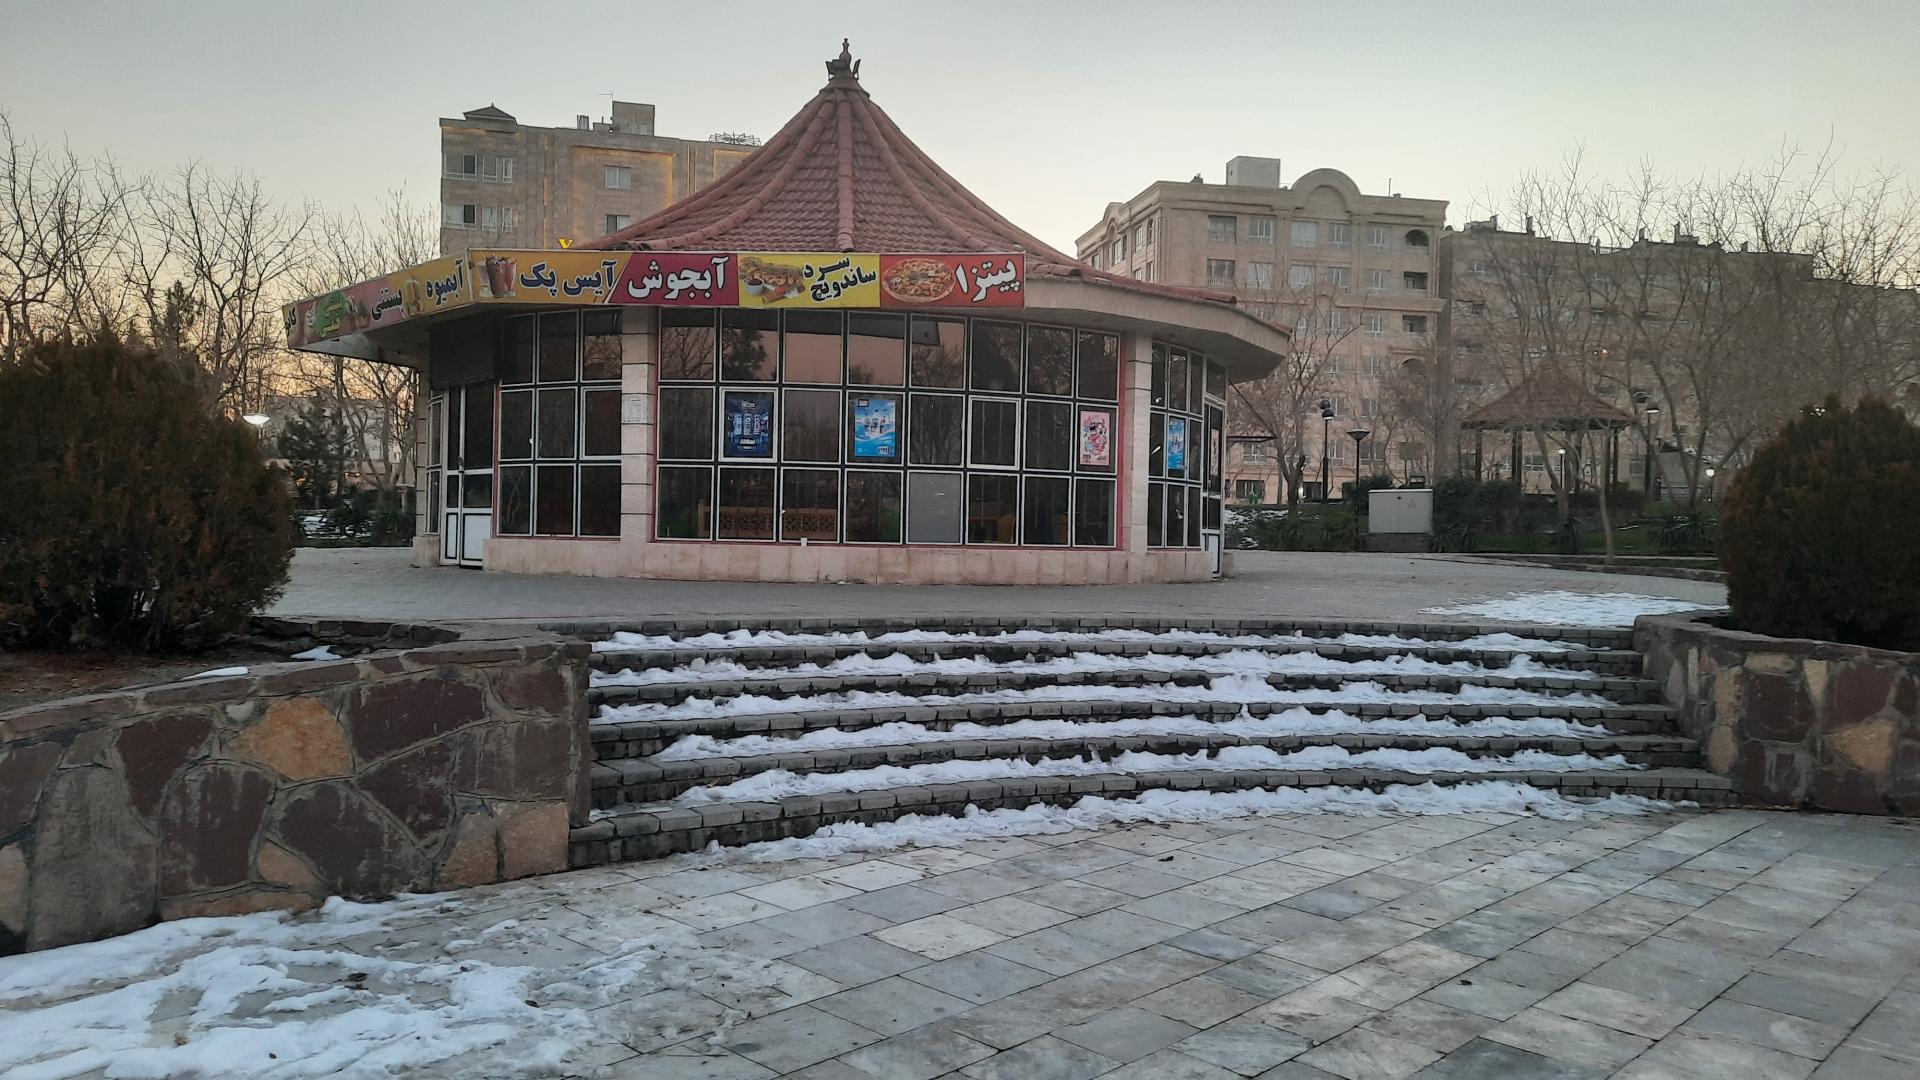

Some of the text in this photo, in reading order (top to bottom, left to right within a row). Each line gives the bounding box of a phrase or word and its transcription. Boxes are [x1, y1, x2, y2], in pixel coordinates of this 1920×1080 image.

[426, 258, 464, 306] آبمیوه
[519, 260, 617, 297] آیس پک
[627, 256, 730, 300] آبجوش
[803, 256, 851, 282] سرد
[810, 266, 877, 301] ساندویچ
[955, 258, 1021, 302] پیتزا
[371, 287, 404, 321] بستنی
